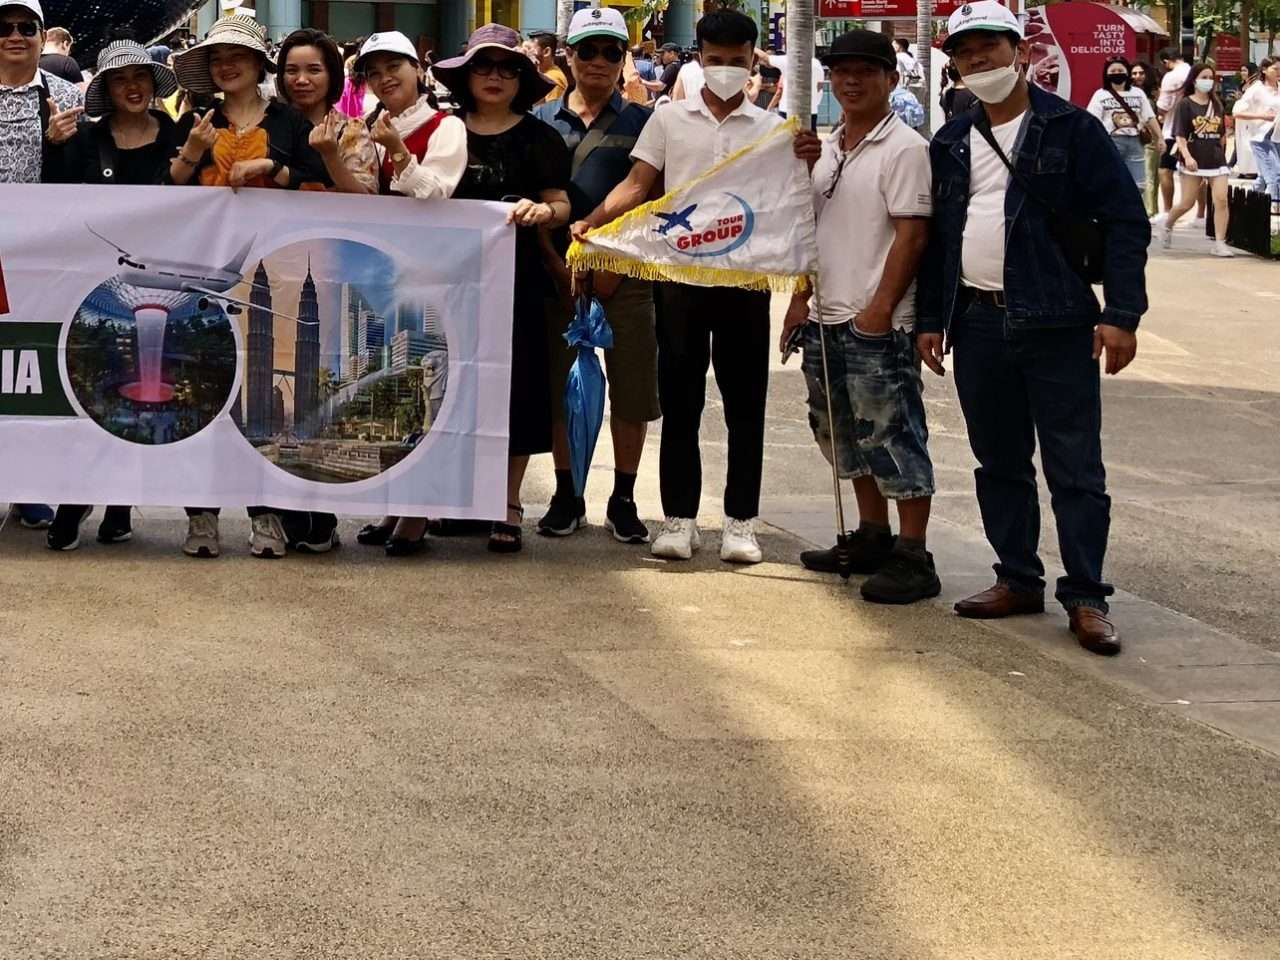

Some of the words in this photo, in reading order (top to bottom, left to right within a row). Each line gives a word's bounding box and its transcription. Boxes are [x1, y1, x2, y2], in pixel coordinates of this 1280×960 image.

[1093, 31, 1125, 39] TASTY
[1100, 38, 1125, 46] INTO
[1071, 46, 1125, 54] DELICIOUS
[717, 214, 744, 227] TOUR
[676, 224, 743, 250] GROUP
